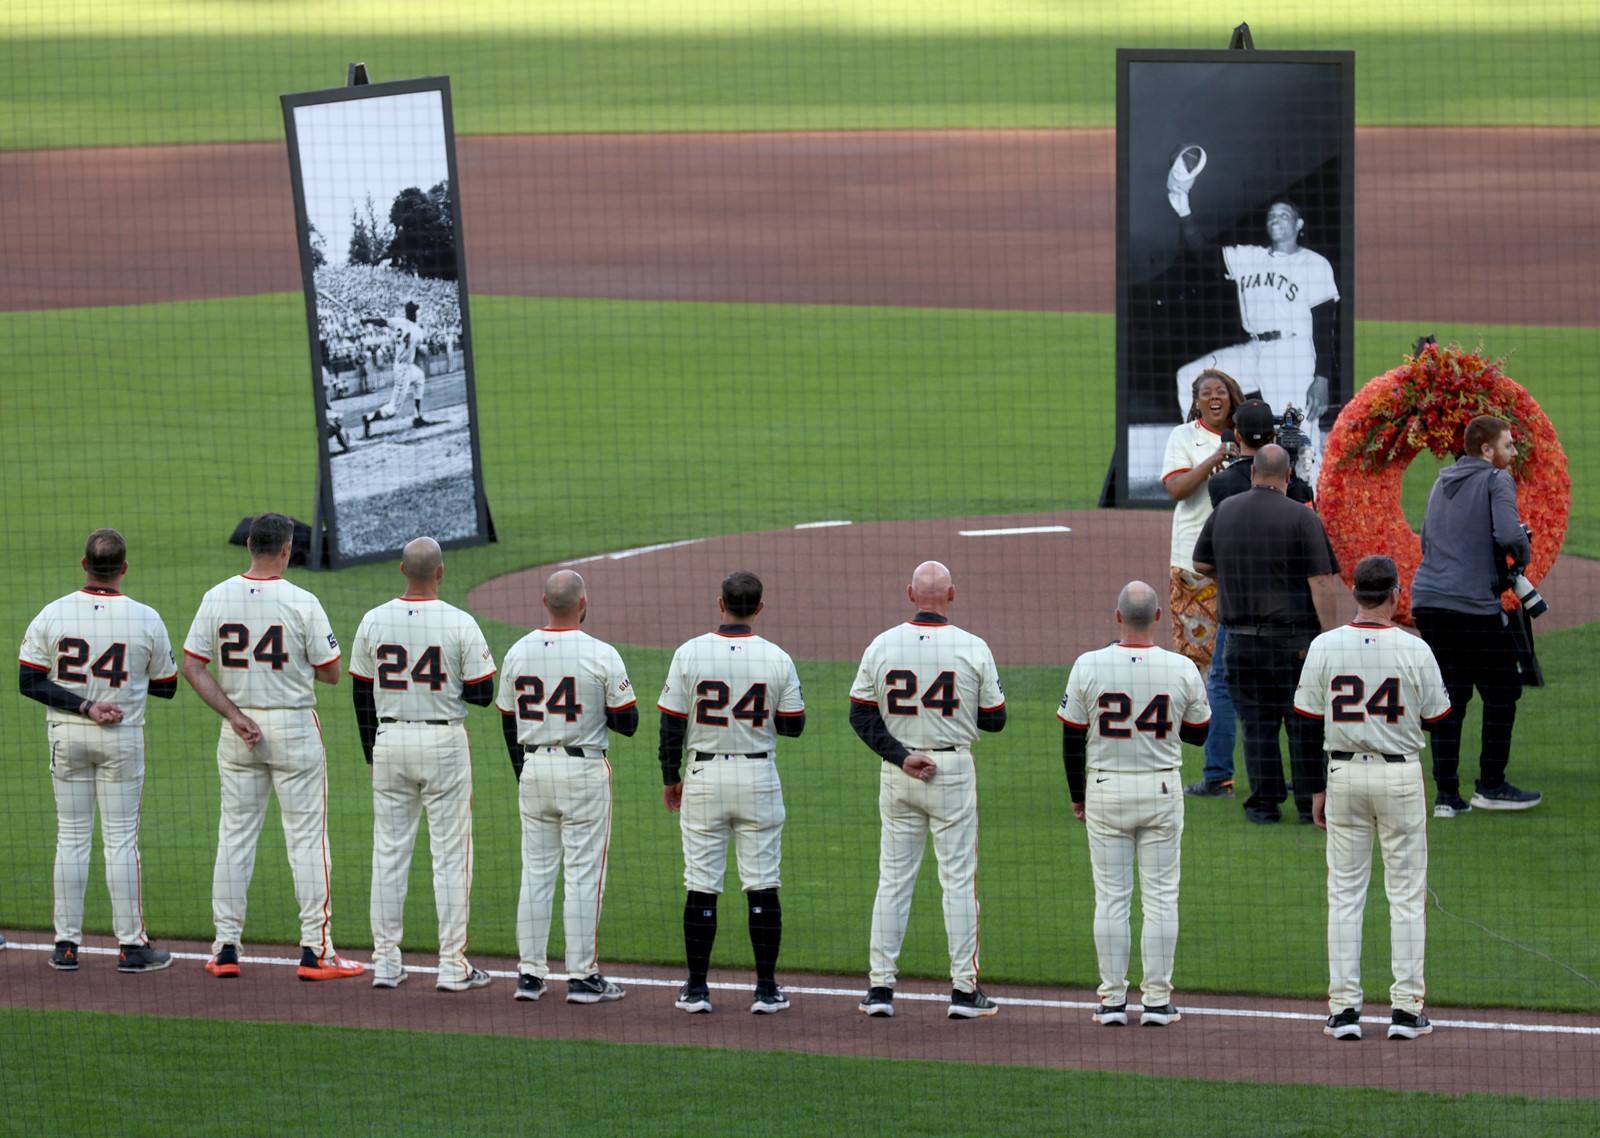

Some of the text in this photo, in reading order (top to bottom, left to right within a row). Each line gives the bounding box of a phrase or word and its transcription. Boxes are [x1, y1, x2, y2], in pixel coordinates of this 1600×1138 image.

[58, 637, 128, 689] 24
[218, 623, 288, 671] 24
[376, 644, 447, 691] 24
[514, 676, 582, 723] 24
[696, 680, 770, 728] 24
[885, 669, 959, 717] 24
[1098, 692, 1173, 740] 24
[1331, 675, 1405, 724] 24
